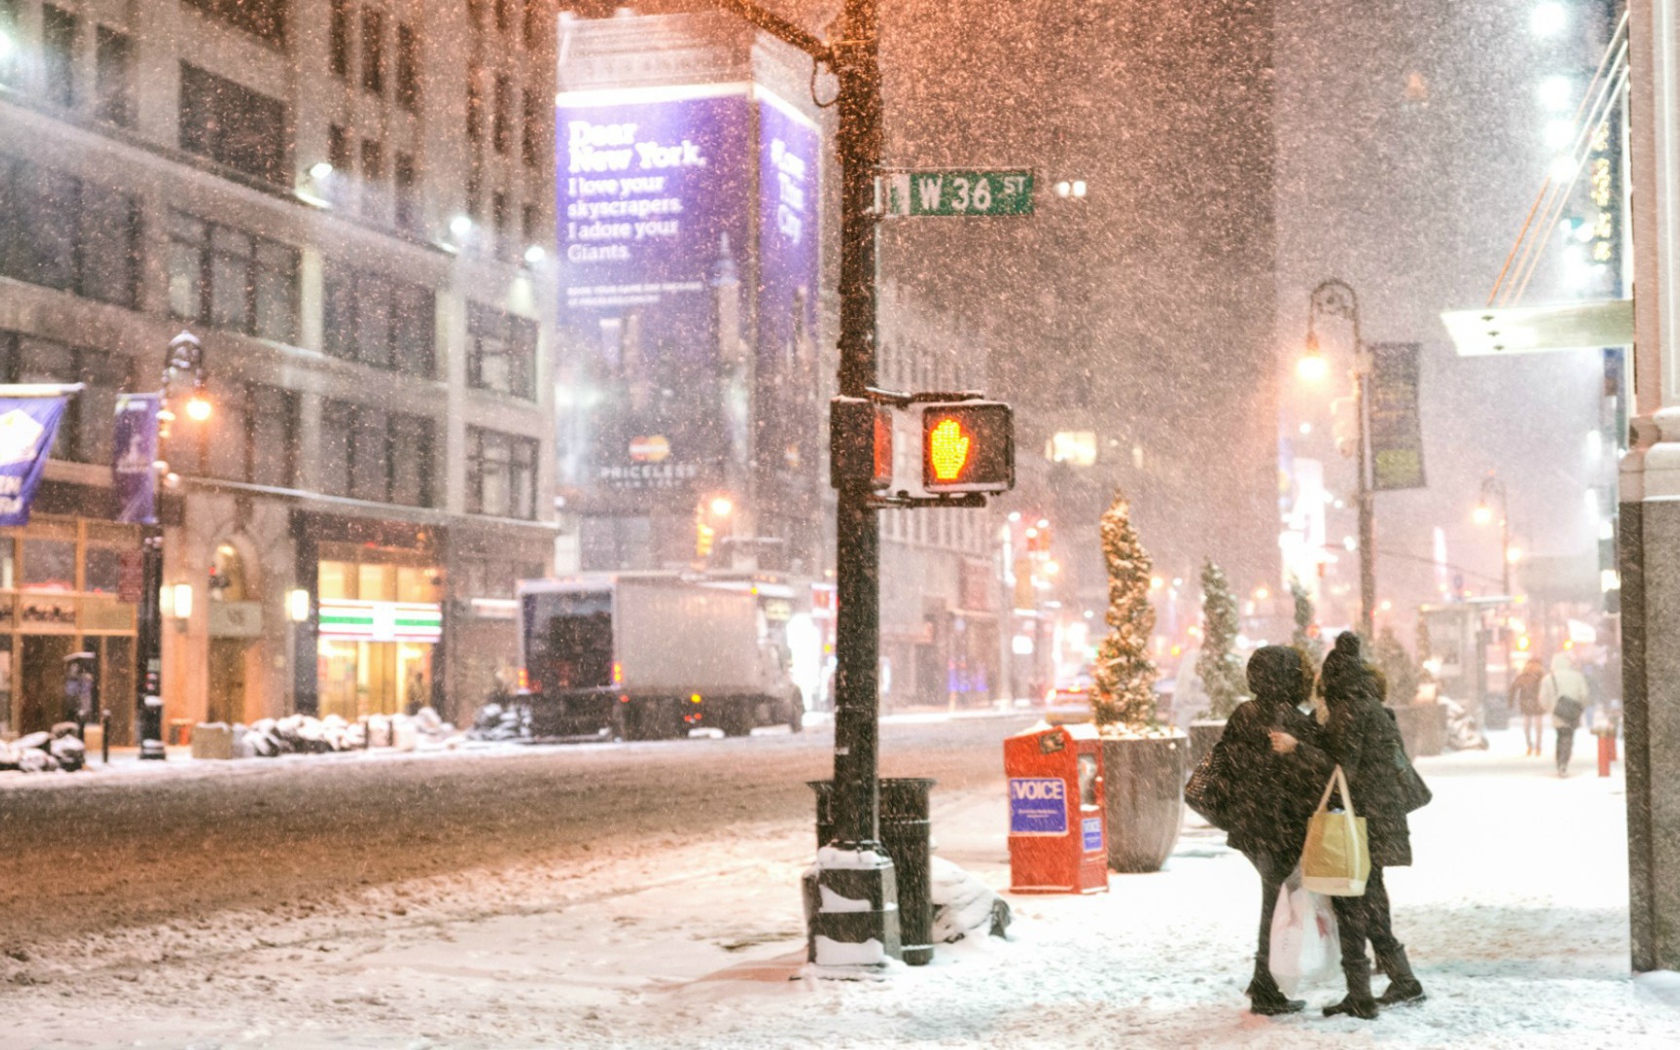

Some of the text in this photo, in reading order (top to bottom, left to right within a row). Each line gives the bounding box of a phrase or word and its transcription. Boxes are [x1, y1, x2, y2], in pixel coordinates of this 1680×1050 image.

[568, 121, 637, 147] Dear
[568, 146, 633, 173] New
[568, 175, 665, 199] I love your
[919, 175, 1026, 211] W 36 ST
[568, 219, 680, 242] I adore your
[1014, 780, 1063, 800] VOICE
